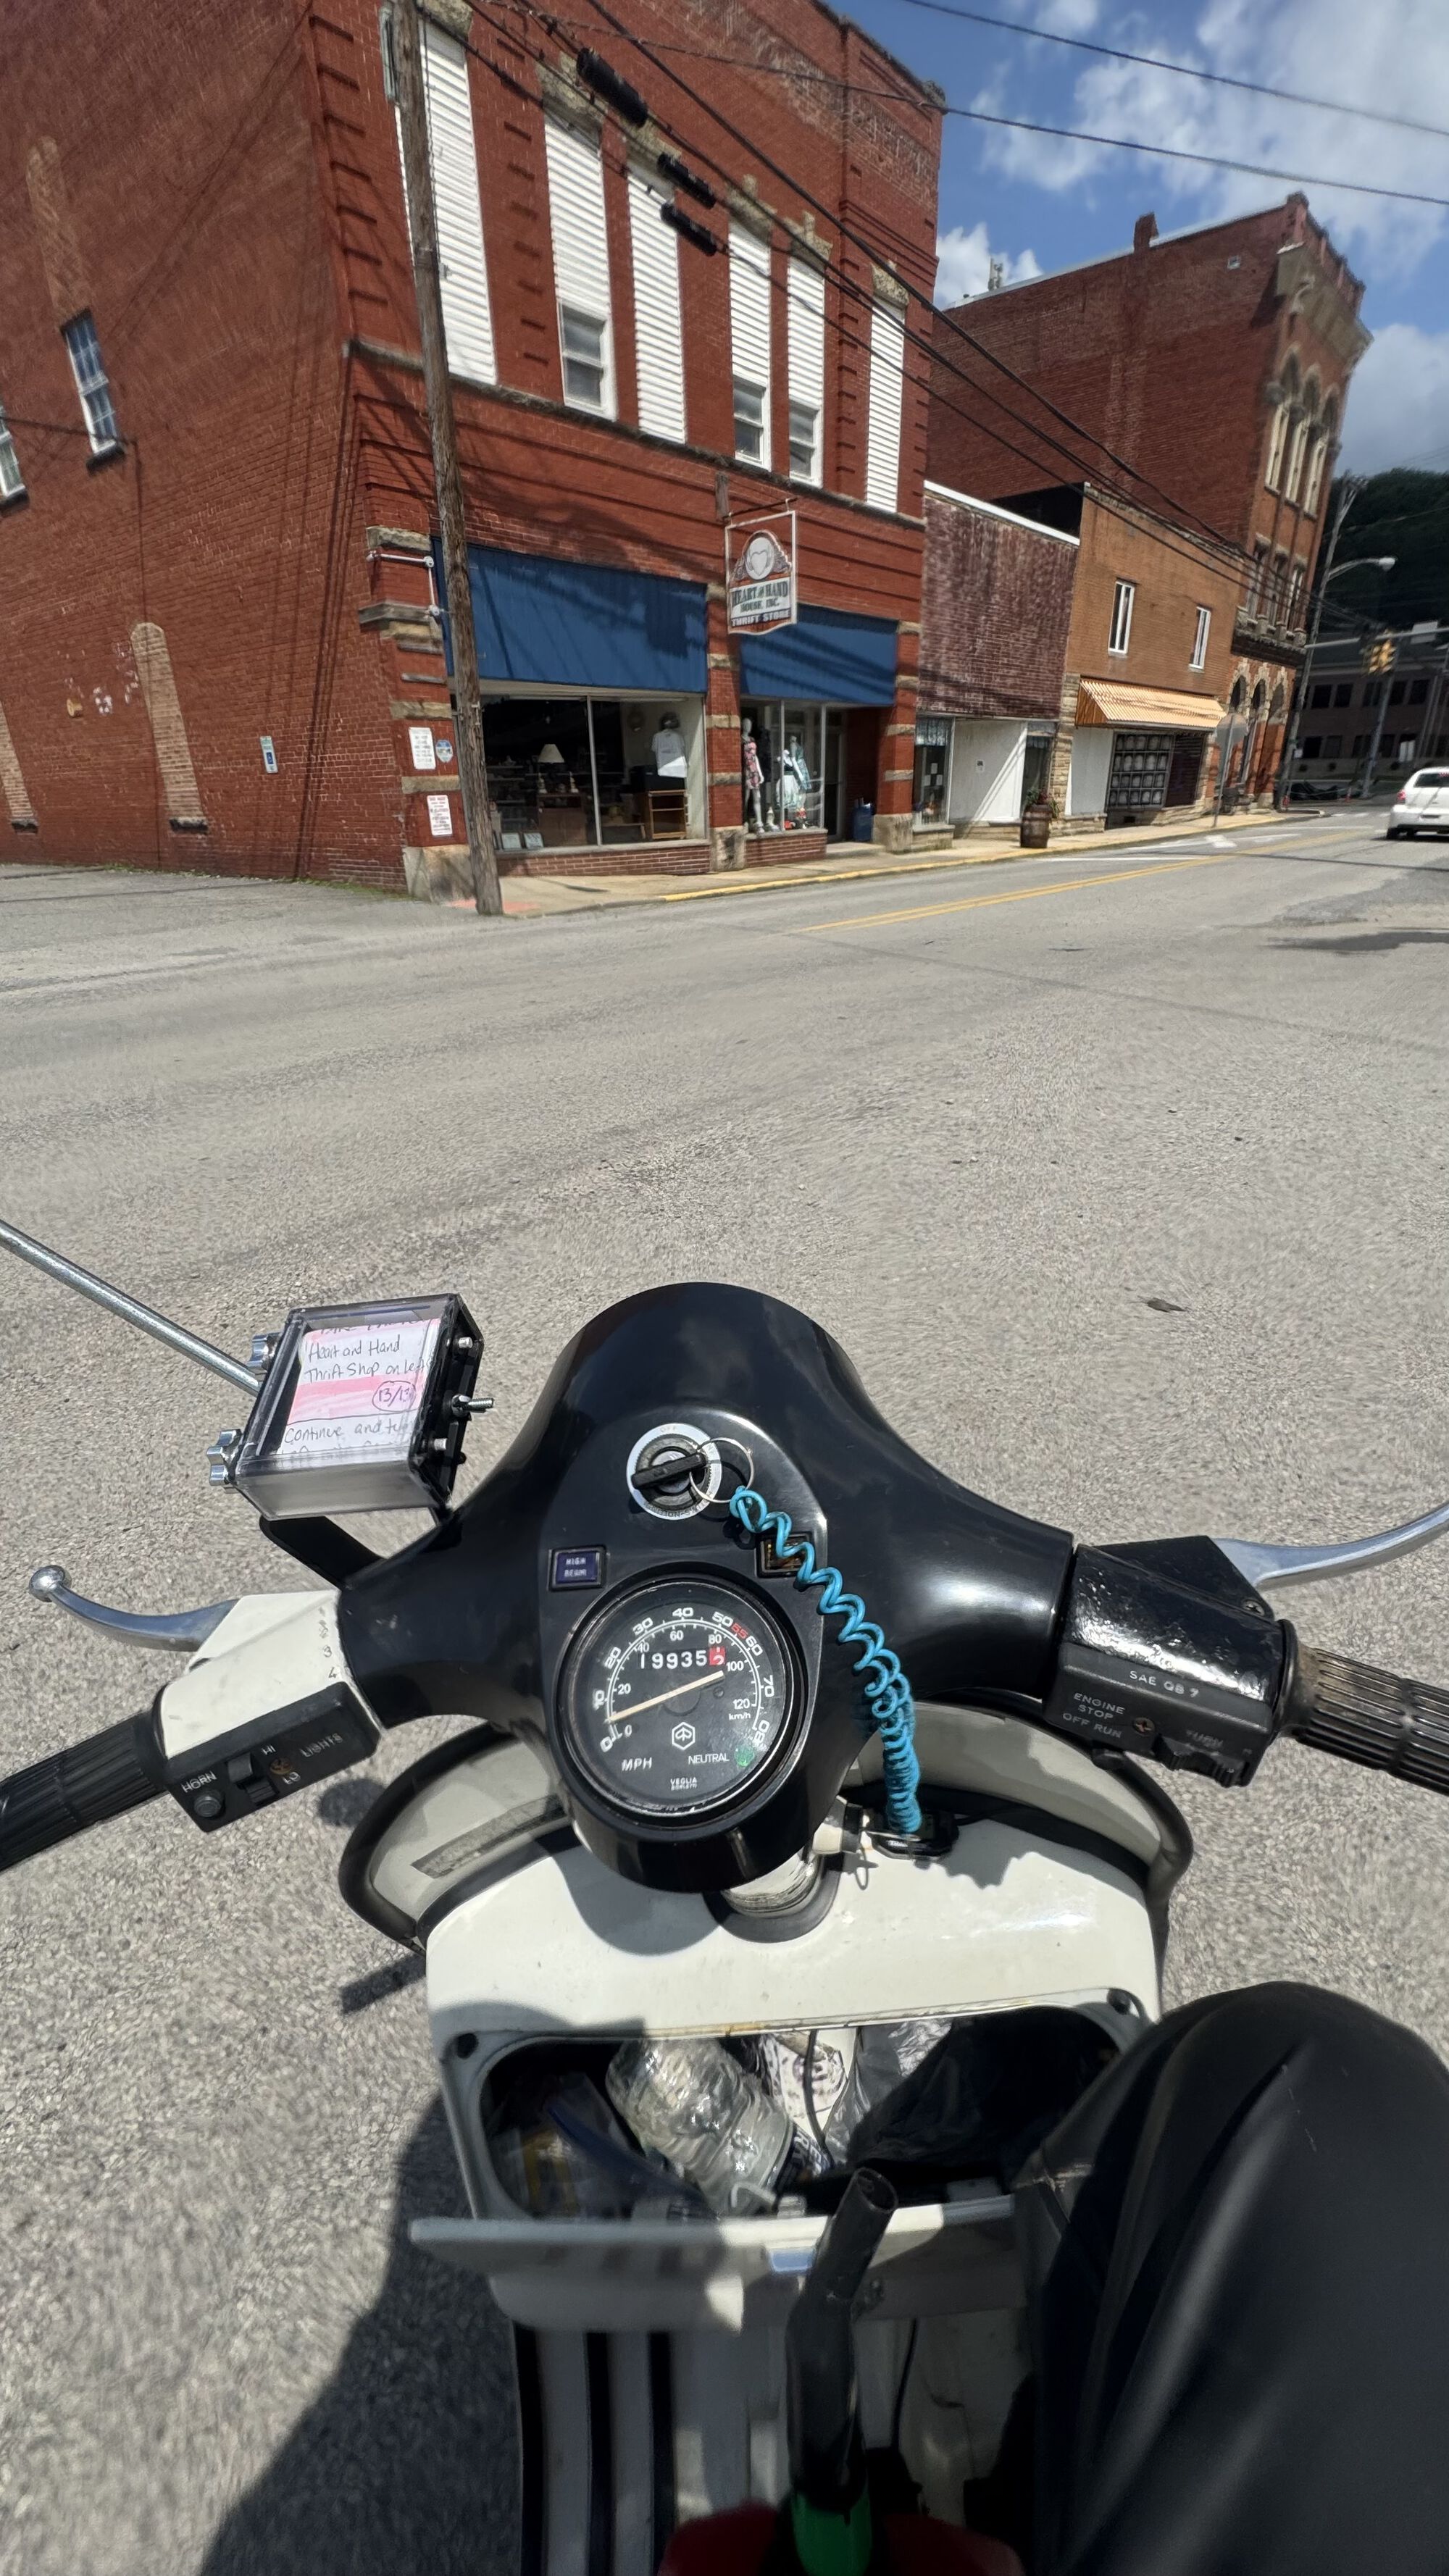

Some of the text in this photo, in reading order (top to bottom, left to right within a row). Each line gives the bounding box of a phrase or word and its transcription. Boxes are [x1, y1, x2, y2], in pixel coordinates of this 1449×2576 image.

[732, 586, 758, 608] HEART
[765, 581, 788, 597] HAND
[731, 610, 789, 627] THRIFT STORE
[309, 1334, 401, 1363] Heart and Hand
[304, 1363, 344, 1384] Thrift
[346, 1361, 380, 1376] Shop
[385, 1365, 399, 1375] on
[284, 1425, 343, 1444] Continue
[354, 1420, 380, 1435] and
[566, 1557, 586, 1565] HIGH
[564, 1568, 588, 1577] BEAM
[672, 1607, 693, 1618] 40
[712, 1611, 733, 1628] 50
[632, 1617, 653, 1636] 30
[731, 1622, 749, 1639] 55
[669, 1630, 685, 1642] 60
[708, 1634, 722, 1644] 80
[637, 1642, 650, 1653] 40
[746, 1635, 763, 1657] 60
[604, 1646, 622, 1670] 20
[726, 1660, 744, 1672] 100
[763, 1675, 774, 1698] 70
[1129, 1670, 1157, 1686] SAE
[617, 1683, 632, 1695] 20
[593, 1689, 605, 1710] 10
[732, 1699, 750, 1710] 120
[1074, 1692, 1126, 1715] ENGINE
[729, 1713, 751, 1721] km/h
[1078, 1704, 1115, 1721] STOP
[624, 1724, 632, 1737] 0
[751, 1719, 770, 1746] 80
[1062, 1713, 1123, 1739] OFF RUN
[262, 1744, 277, 1755] HI
[299, 1733, 343, 1758] LIGHTS
[600, 1736, 614, 1753] 0
[622, 1757, 653, 1772] MPH
[688, 1753, 730, 1765] NEUTRAL
[180, 1770, 217, 1793] HORN
[281, 1771, 301, 1785] LO
